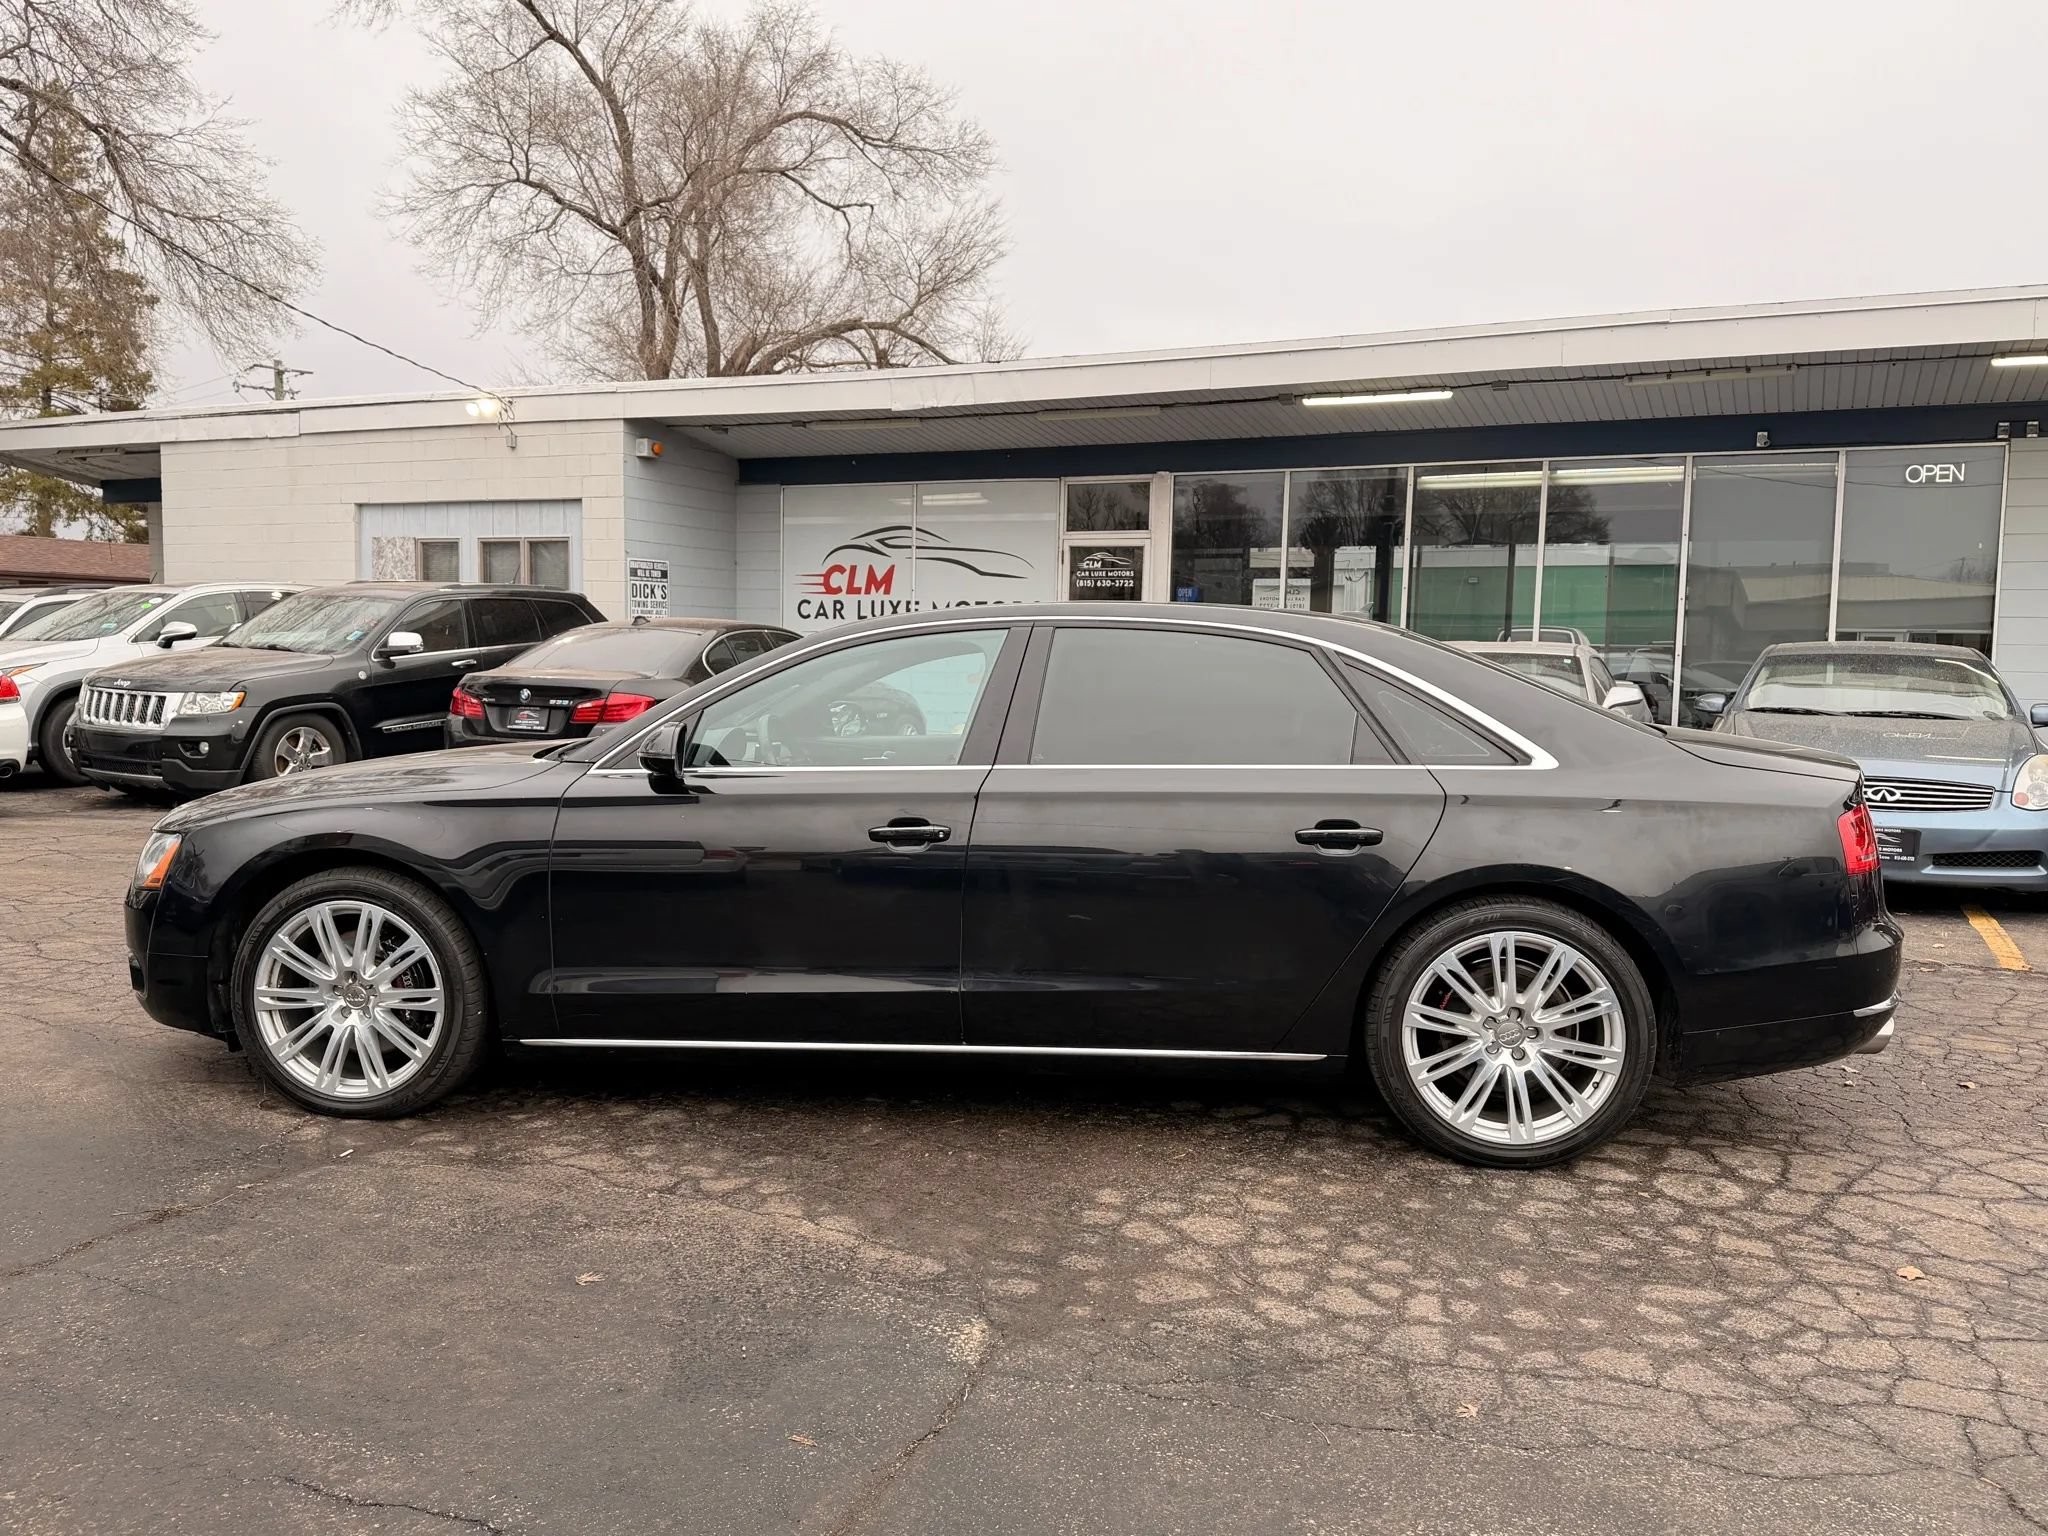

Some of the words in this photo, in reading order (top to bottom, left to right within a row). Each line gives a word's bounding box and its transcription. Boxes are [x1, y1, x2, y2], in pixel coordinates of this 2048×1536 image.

[1905, 463, 1965, 483] OPEN
[823, 564, 896, 595] CLM
[1076, 579, 1094, 587] (815)
[632, 583, 667, 600] DICK'S
[1178, 588, 1192, 597] OPEN
[797, 599, 845, 619] CAR
